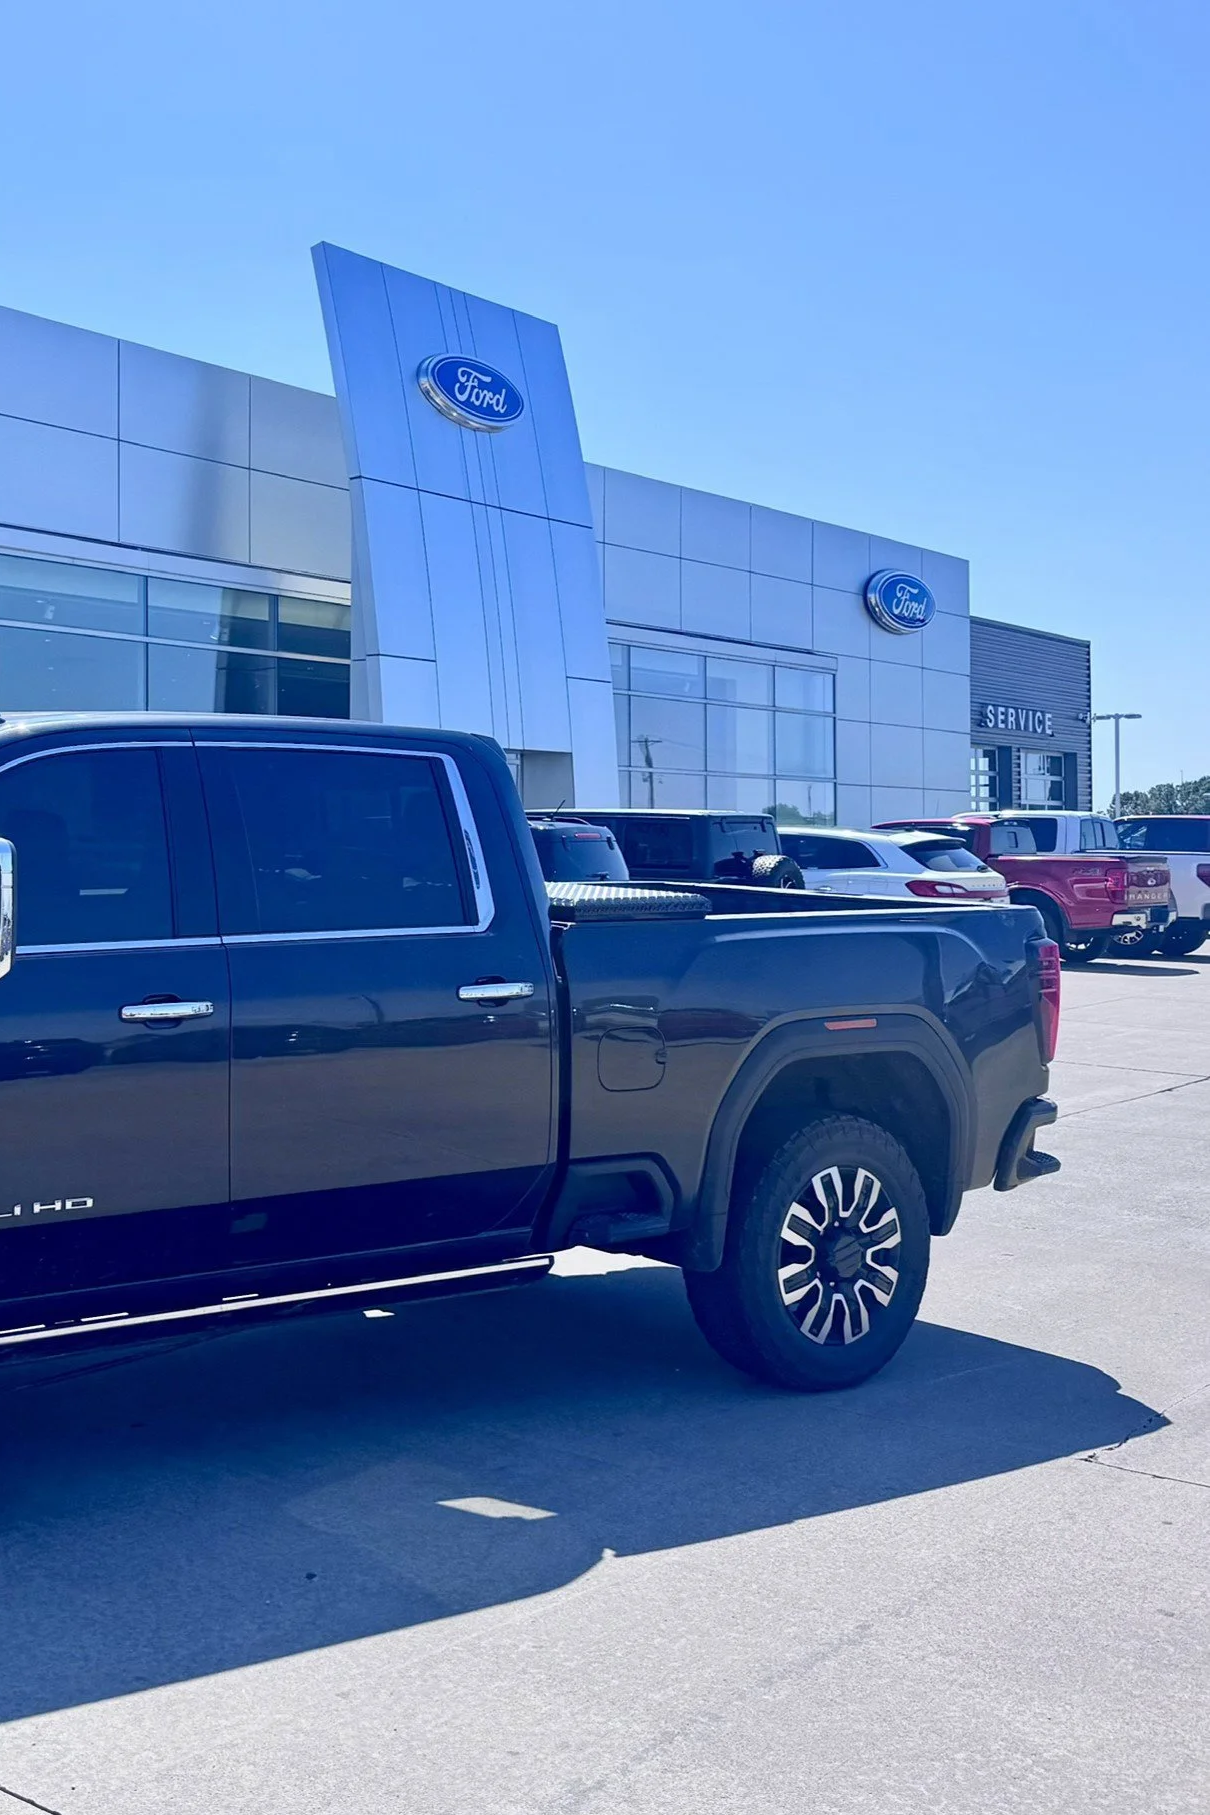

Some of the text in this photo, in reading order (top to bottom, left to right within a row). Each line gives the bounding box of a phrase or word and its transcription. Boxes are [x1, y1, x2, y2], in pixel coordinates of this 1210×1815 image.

[454, 367, 507, 413] Ford
[892, 583, 928, 620] Ford
[986, 705, 1053, 735] SERVICE
[1129, 891, 1168, 901] RANGER
[33, 1196, 94, 1214] HD
